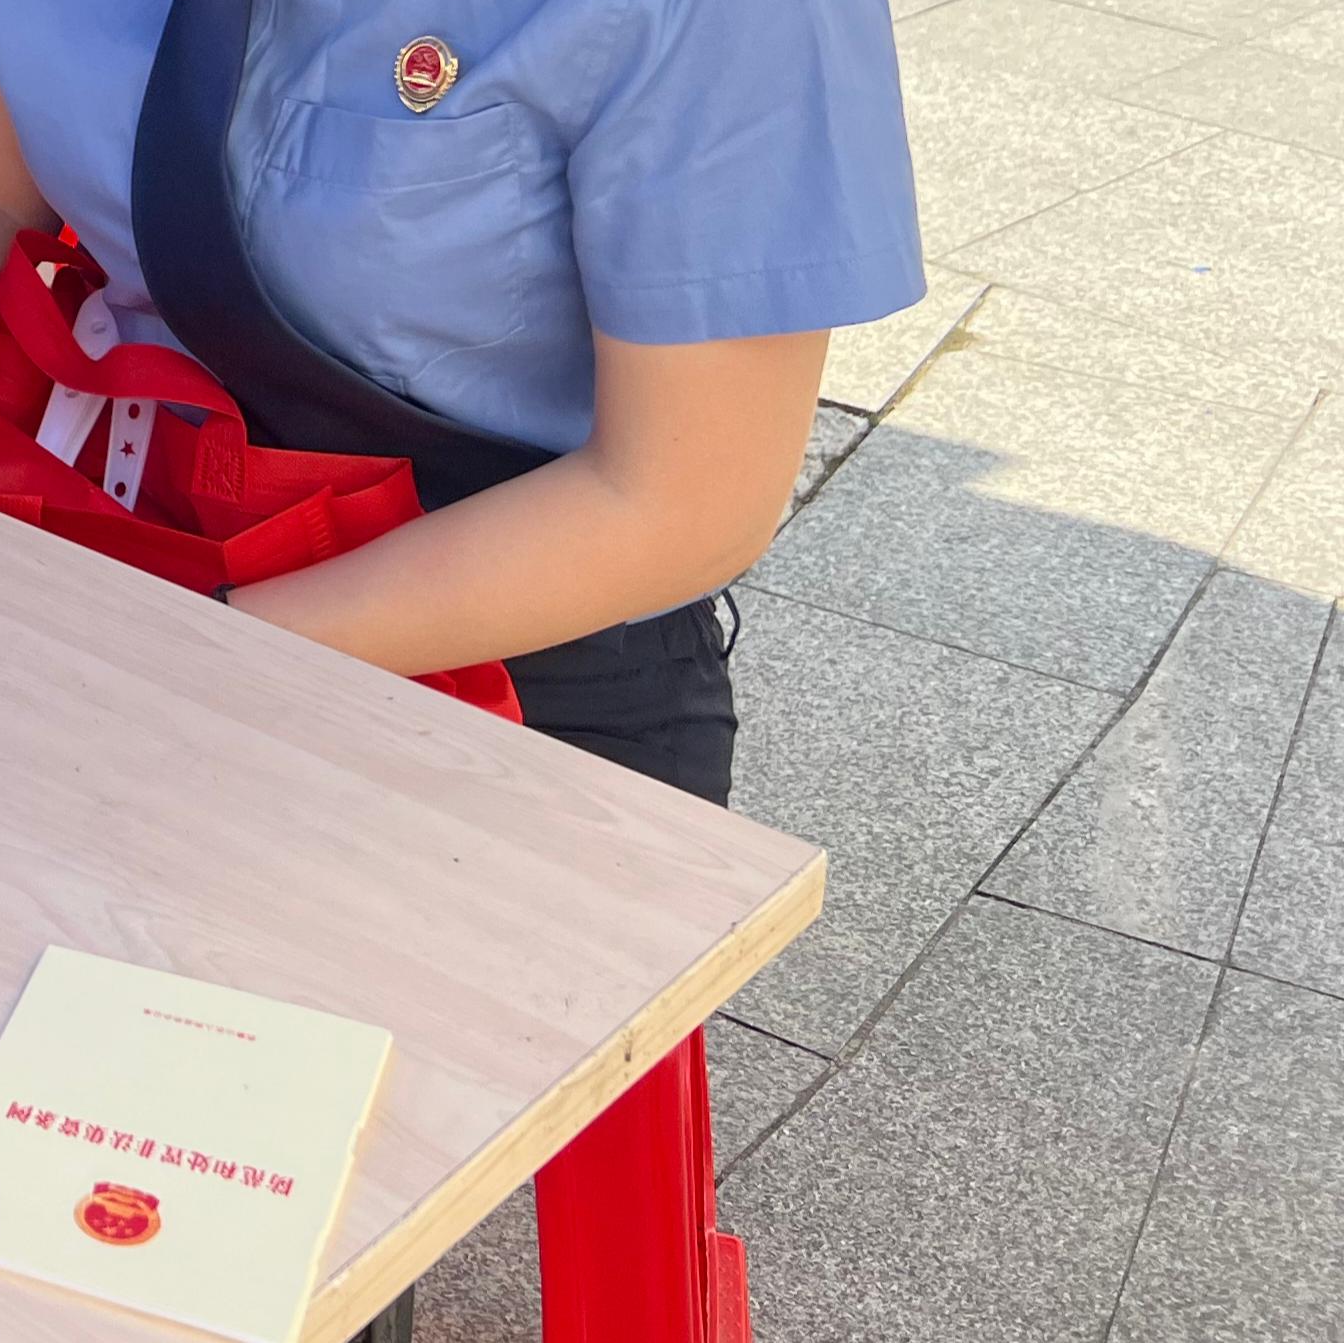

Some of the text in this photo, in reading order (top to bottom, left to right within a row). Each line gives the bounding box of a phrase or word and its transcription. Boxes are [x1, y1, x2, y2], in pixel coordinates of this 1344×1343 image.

[5, 1101, 294, 1198] 防范和处置非法集资条例
